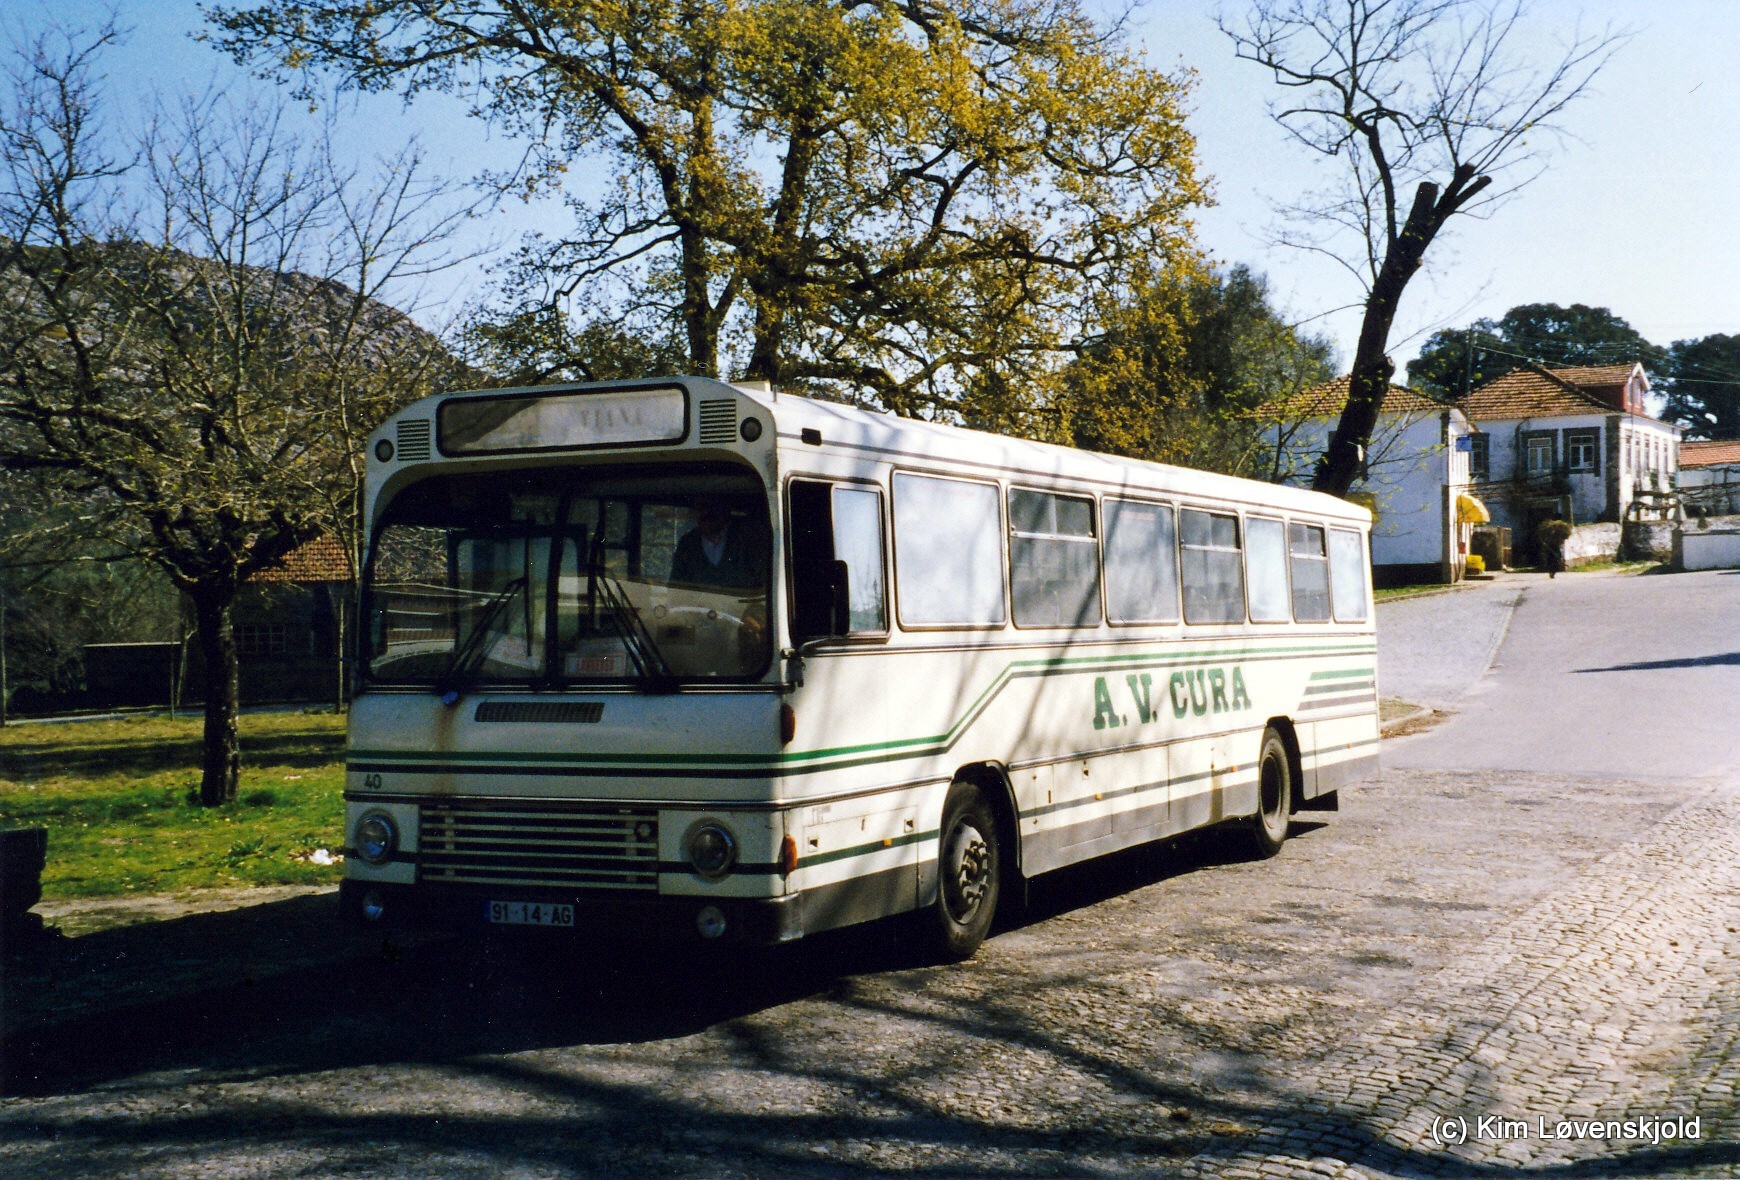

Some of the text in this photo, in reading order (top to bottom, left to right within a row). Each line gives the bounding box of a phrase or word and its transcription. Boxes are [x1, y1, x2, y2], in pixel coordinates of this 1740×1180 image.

[1093, 665, 1252, 730] A.V. CURA
[364, 773, 382, 789] 40
